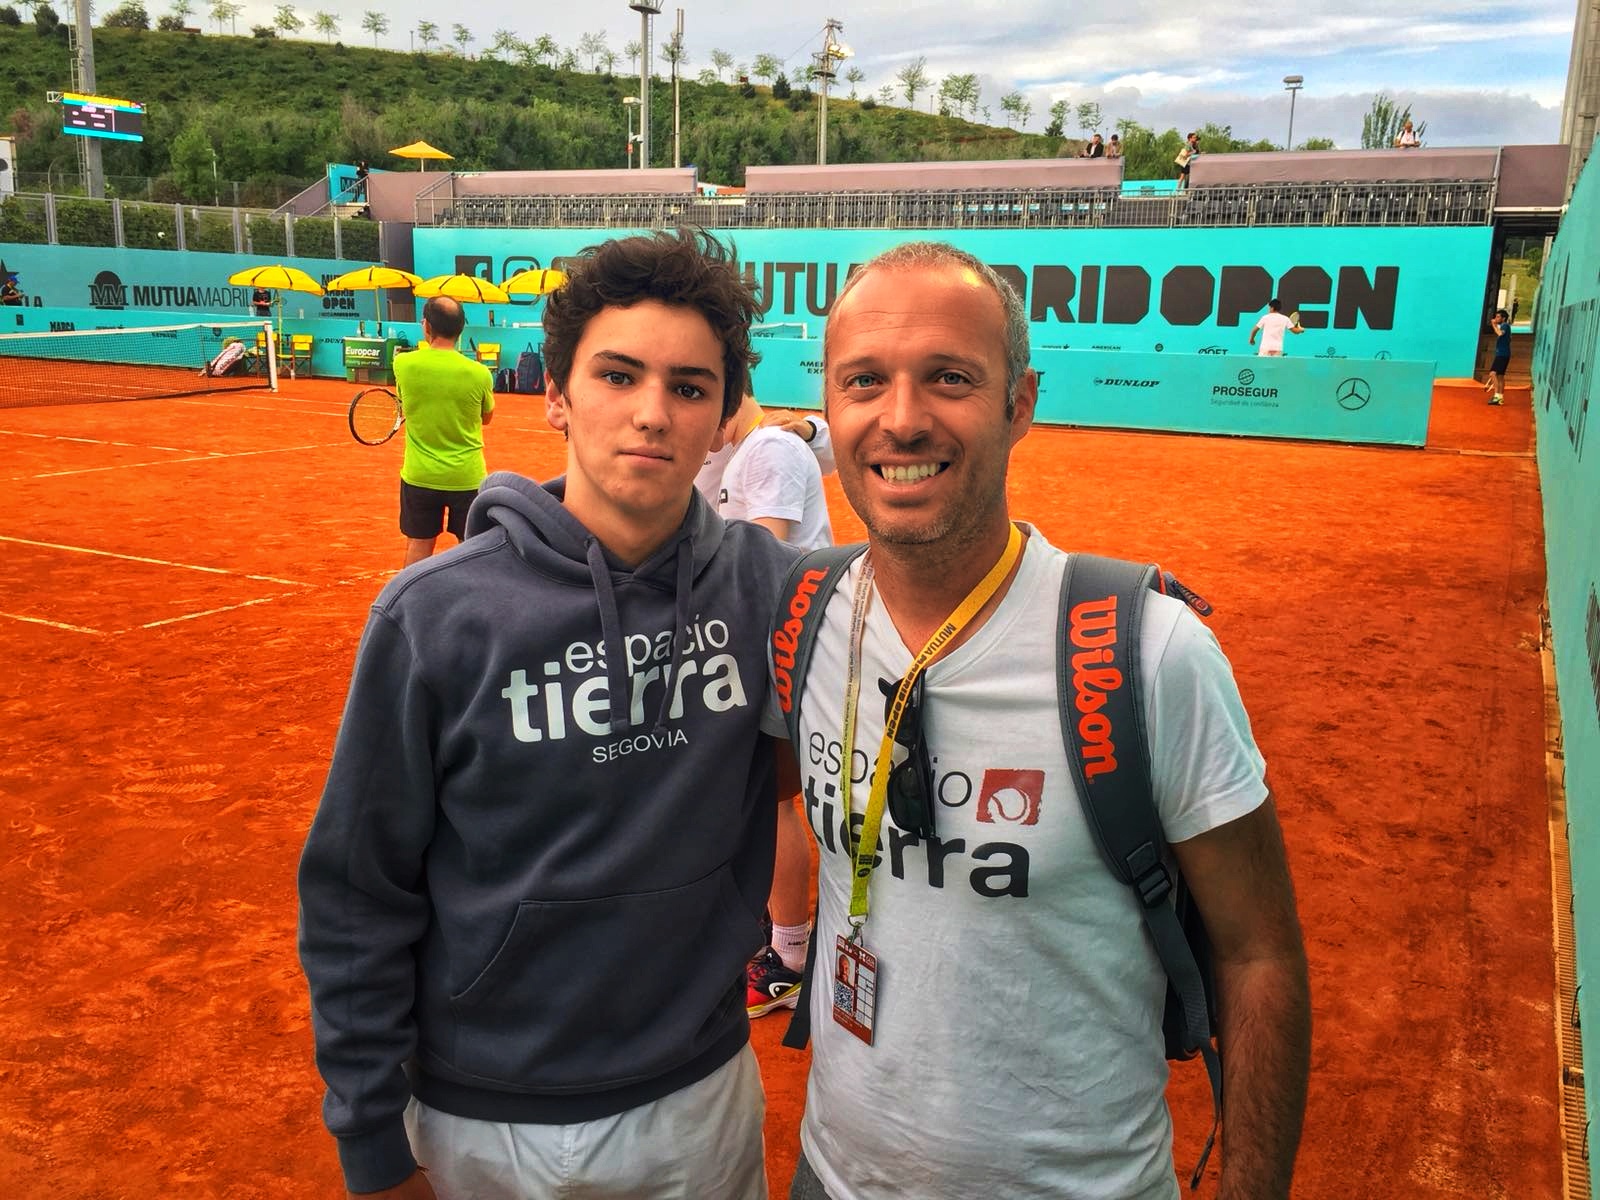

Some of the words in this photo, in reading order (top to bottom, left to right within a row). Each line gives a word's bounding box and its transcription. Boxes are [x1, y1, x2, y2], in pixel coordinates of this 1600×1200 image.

[1159, 265, 1400, 330] OPEN
[50, 321, 75, 332] MARCA
[345, 346, 381, 357] Europcar
[1104, 378, 1160, 388] DUNLOP
[1212, 386, 1278, 398] PROSEGUR
[926, 622, 957, 656] MUTUA
[898, 653, 928, 700] MADRID
[1069, 595, 1124, 780] Wilson
[501, 653, 748, 743] tierra
[886, 701, 903, 740] OPEN
[592, 728, 689, 763] SEGOVIA
